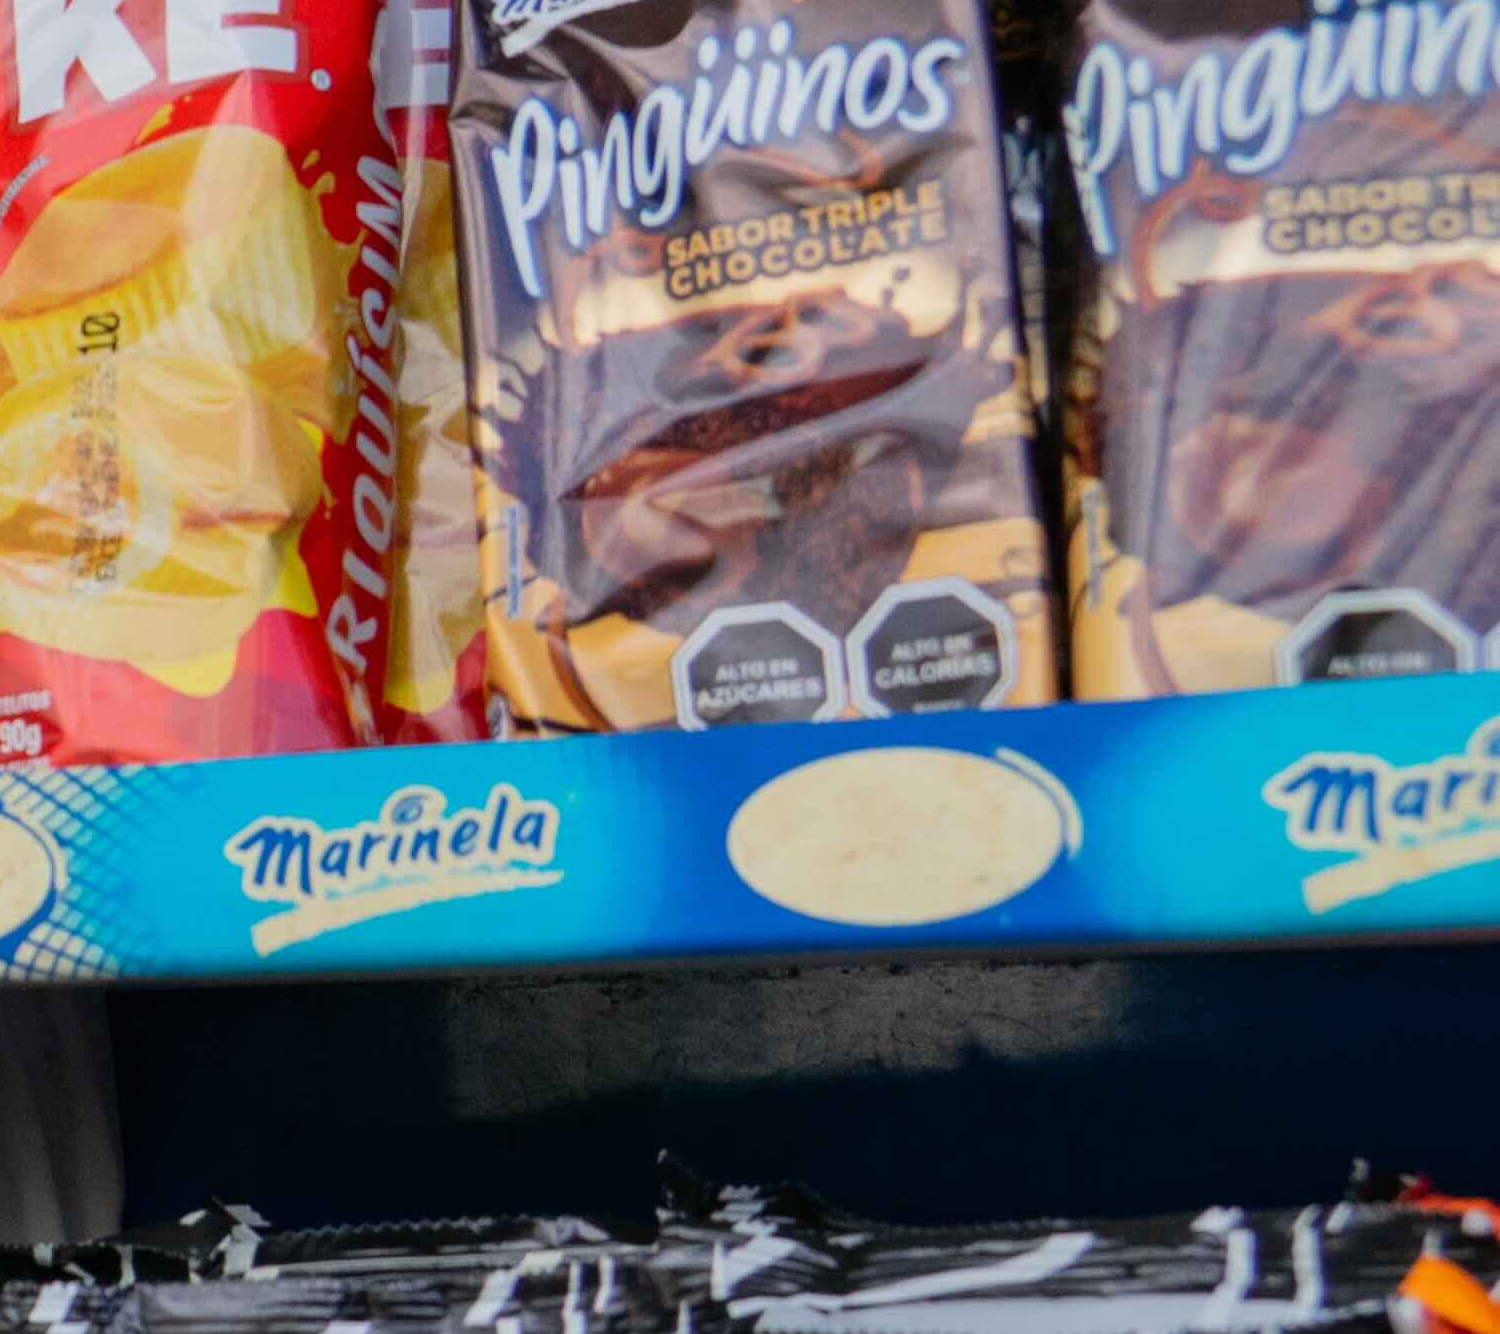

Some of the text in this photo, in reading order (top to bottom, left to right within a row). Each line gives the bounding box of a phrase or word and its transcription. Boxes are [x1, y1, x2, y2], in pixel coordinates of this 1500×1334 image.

[491, 19, 968, 299] Pingüinos
[666, 180, 943, 268] SABOR TRIPLE
[666, 210, 949, 301] CHOCOLATE
[694, 670, 823, 712] AZÚCARES
[713, 656, 799, 681] ALTO EN
[888, 632, 973, 663] ALTO EN
[236, 793, 544, 897] Marinela
